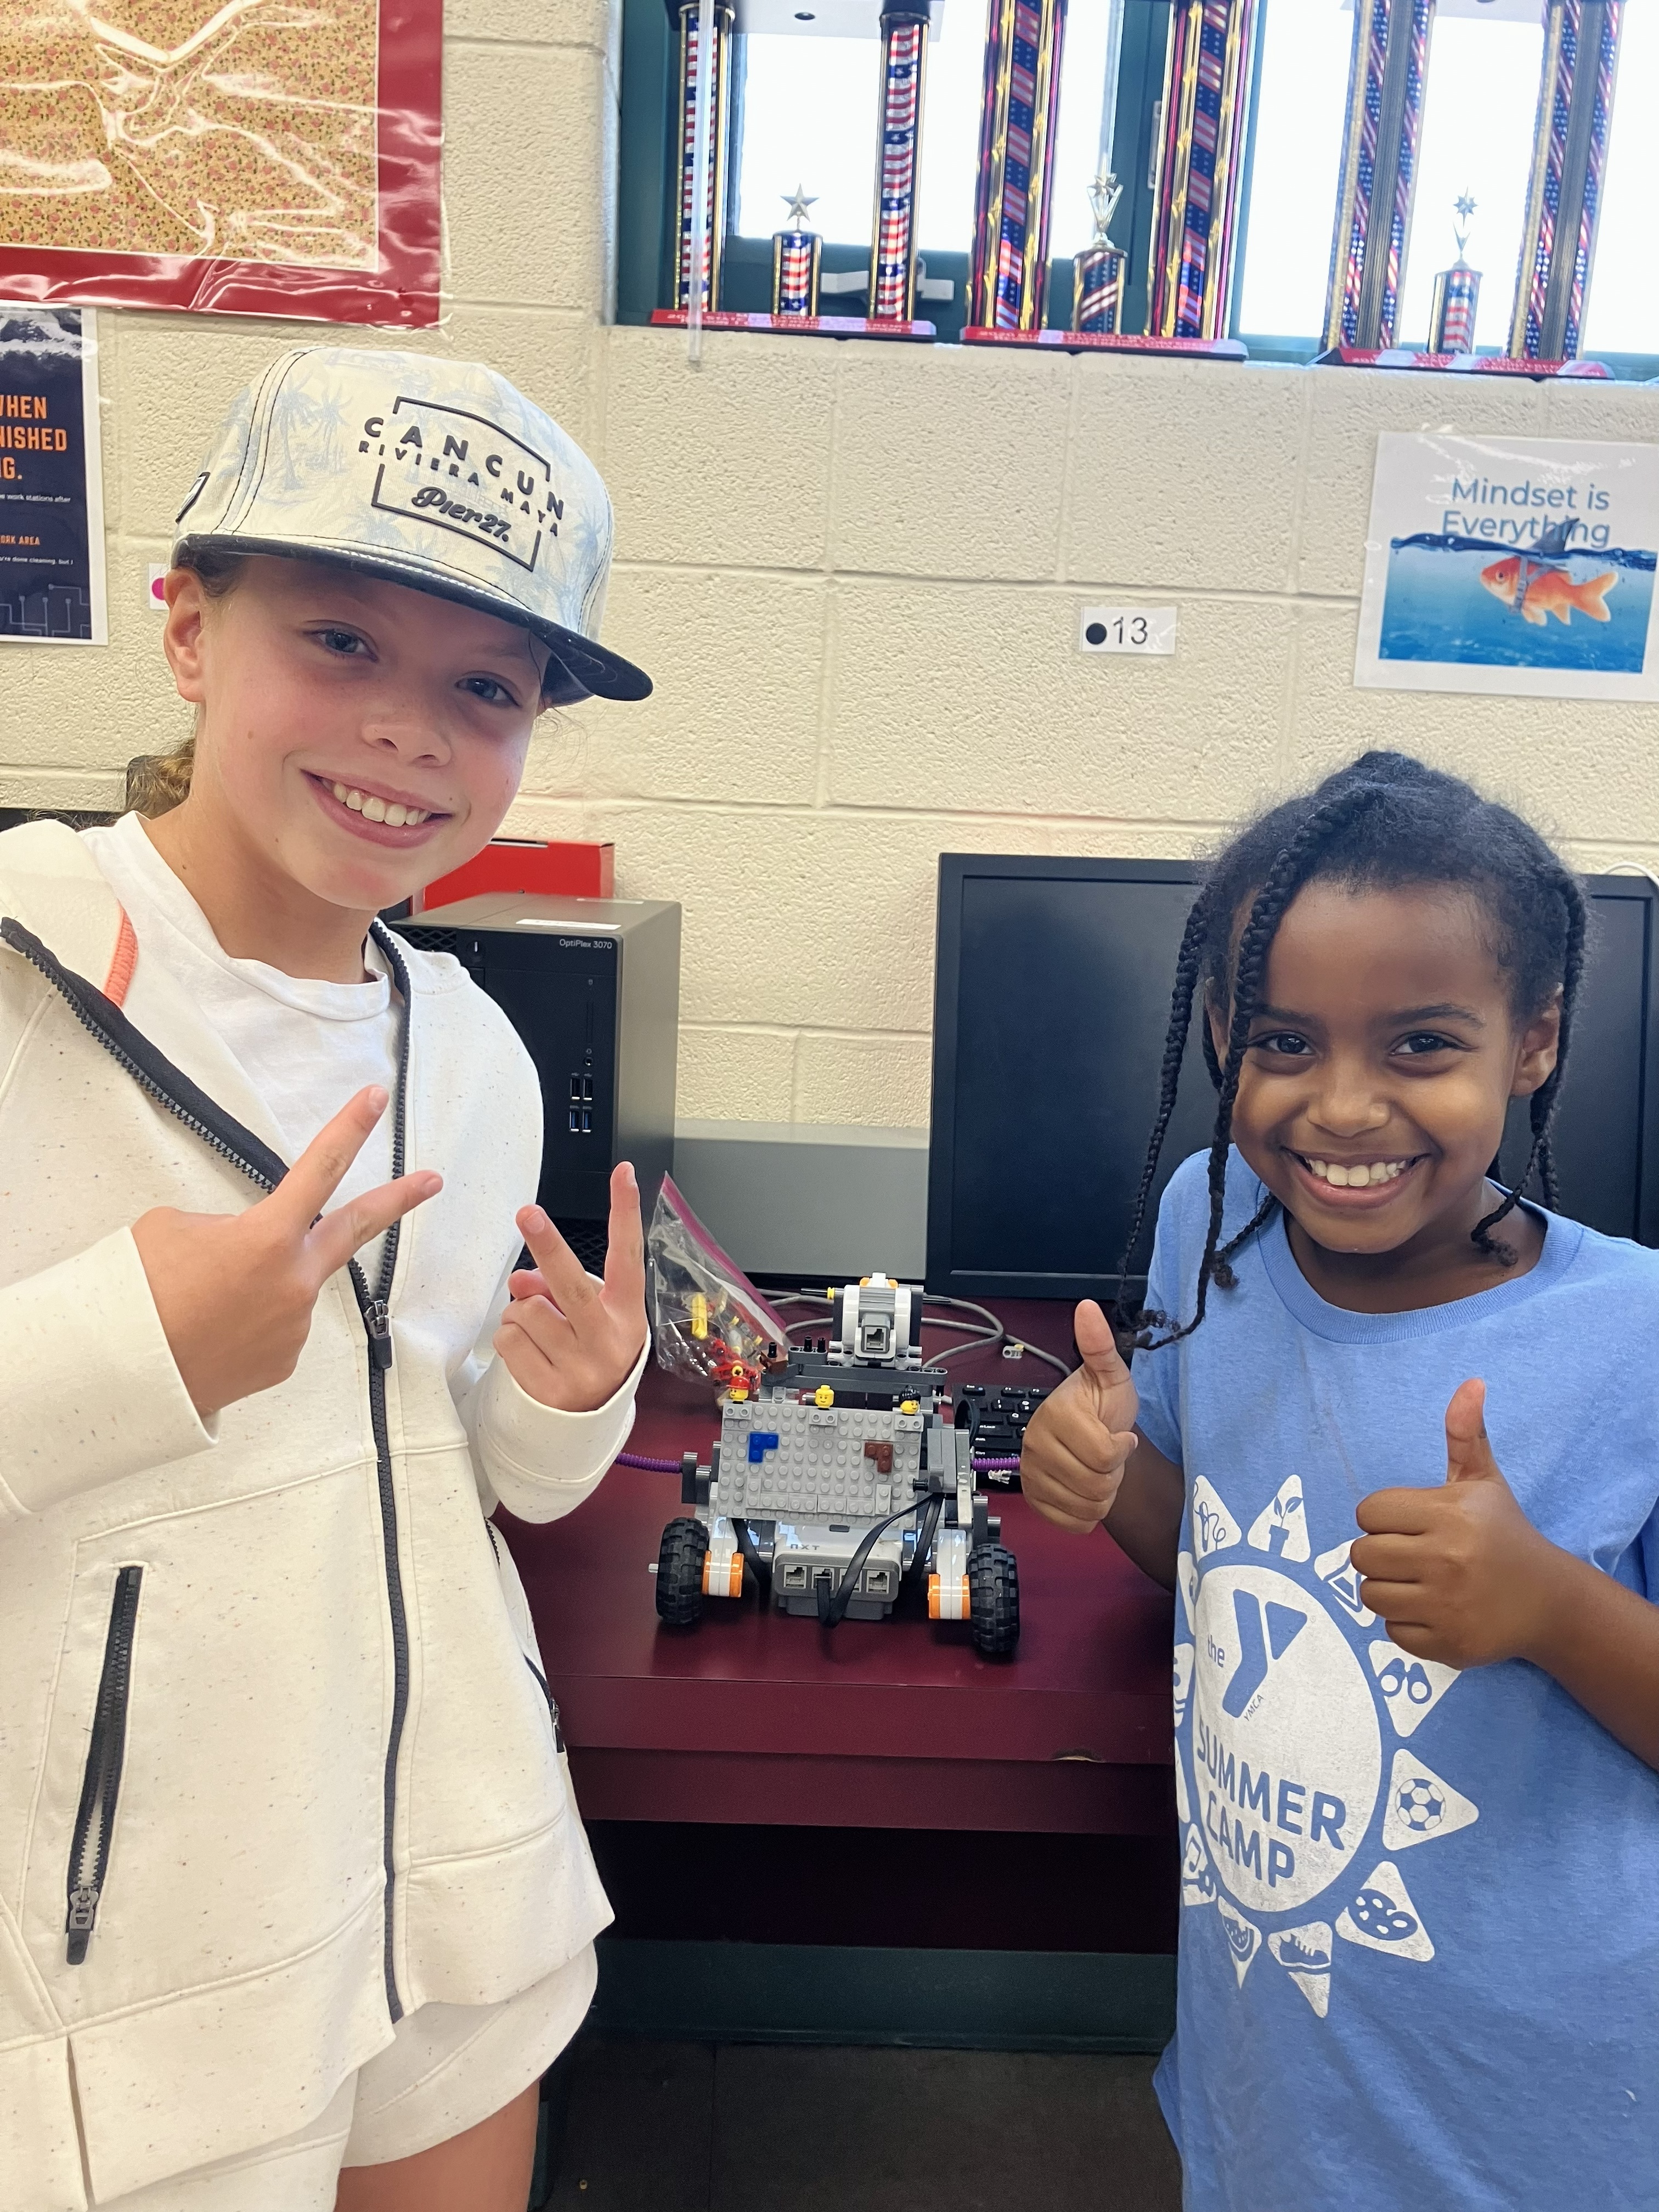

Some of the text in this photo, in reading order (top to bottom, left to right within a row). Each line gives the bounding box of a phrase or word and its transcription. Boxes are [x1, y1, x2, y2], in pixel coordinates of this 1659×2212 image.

[0, 456, 22, 479] G.
[364, 417, 565, 520] CANCUN
[358, 441, 558, 537] RIVIERA MAYA
[1452, 477, 1611, 511] Mindset is
[1443, 510, 1610, 548] Everything
[1113, 616, 1148, 645] 13
[559, 938, 613, 949] OptiPlex 3070
[1207, 1634, 1226, 1668] the
[1243, 1694, 1265, 1722] YMCA
[1197, 1717, 1346, 1850] SUMMER
[1207, 1790, 1295, 1888] CAMP
